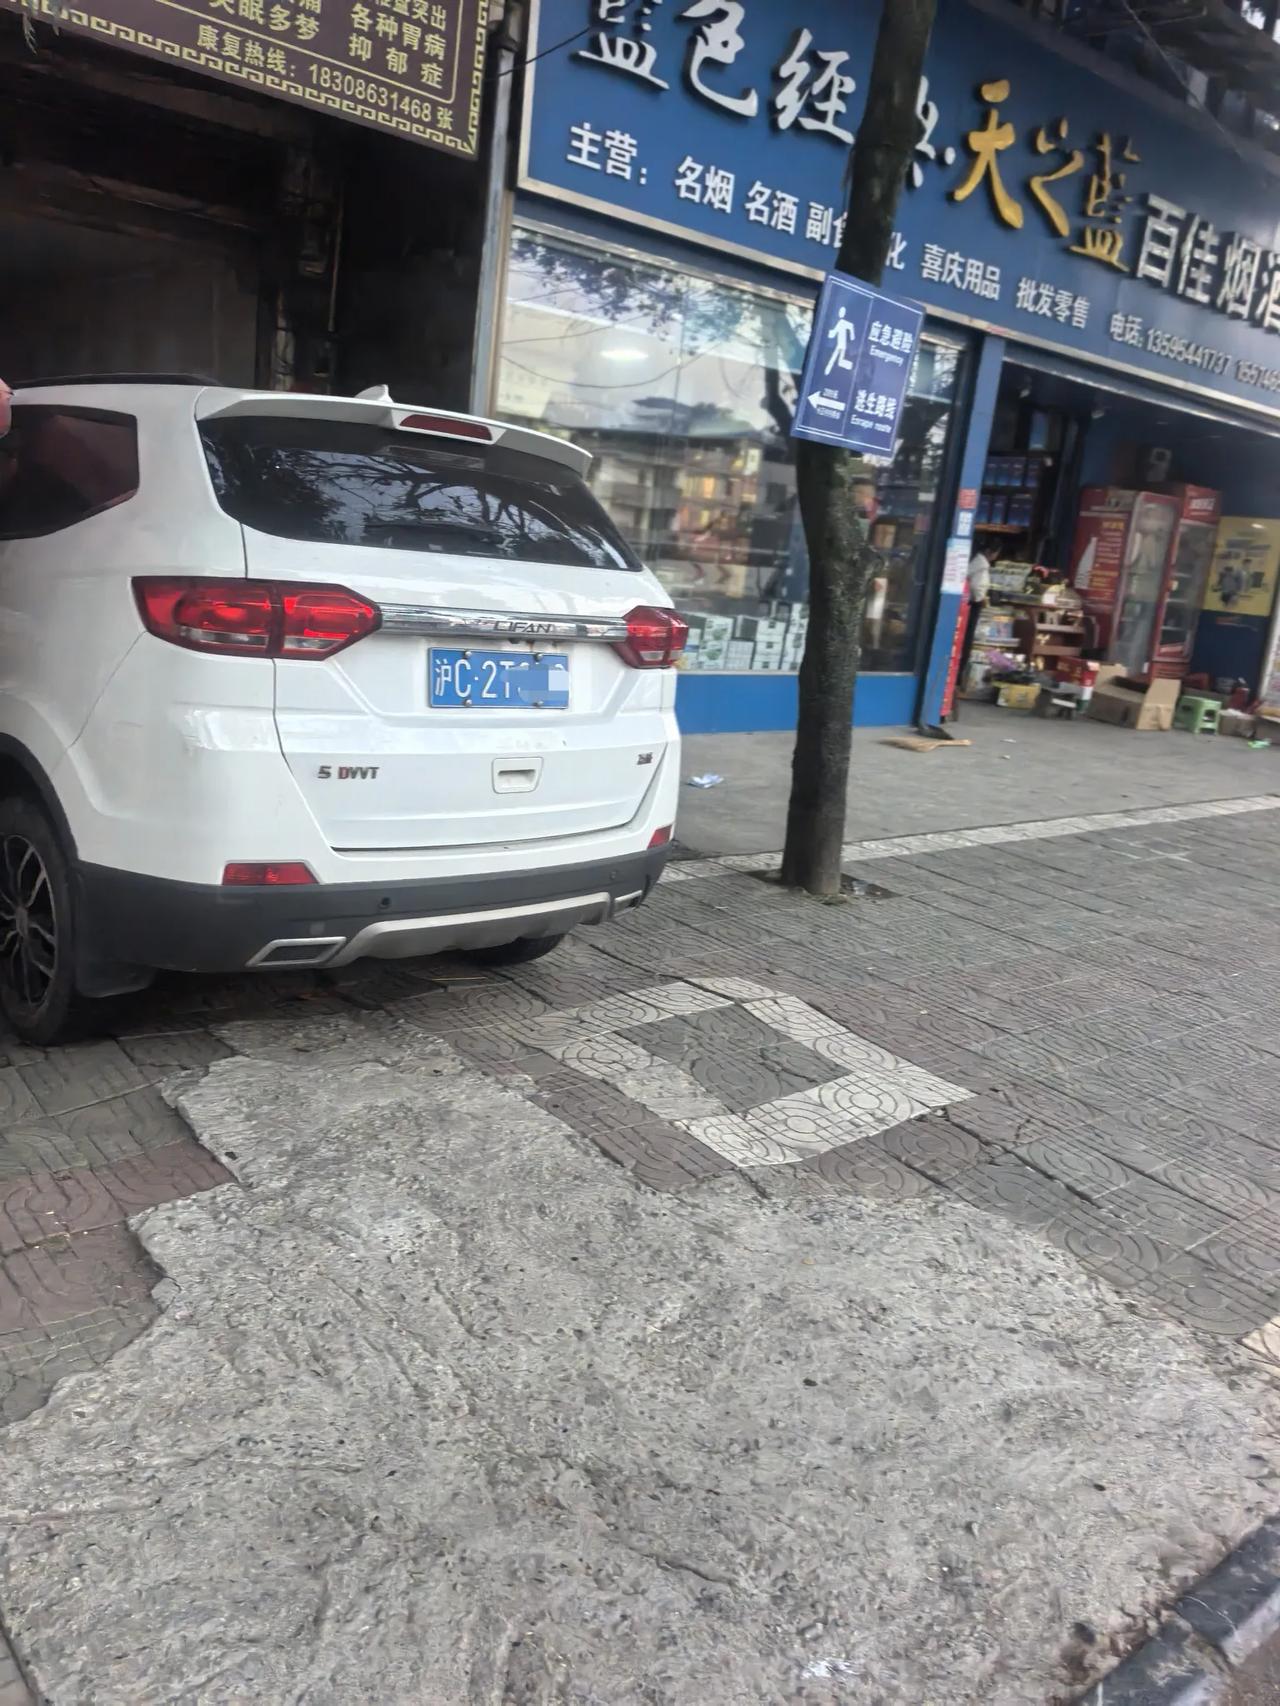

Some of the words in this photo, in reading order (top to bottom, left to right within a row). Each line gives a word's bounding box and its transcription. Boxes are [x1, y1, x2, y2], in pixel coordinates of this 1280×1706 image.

[351, 3, 447, 60] 各种胃病
[308, 64, 433, 122] 18308631468
[436, 107, 454, 131] 张
[674, 156, 736, 214] 名烟
[744, 181, 799, 235] 名酒
[921, 243, 1001, 301] 喜庆用品
[1016, 277, 1091, 329] 批发零售
